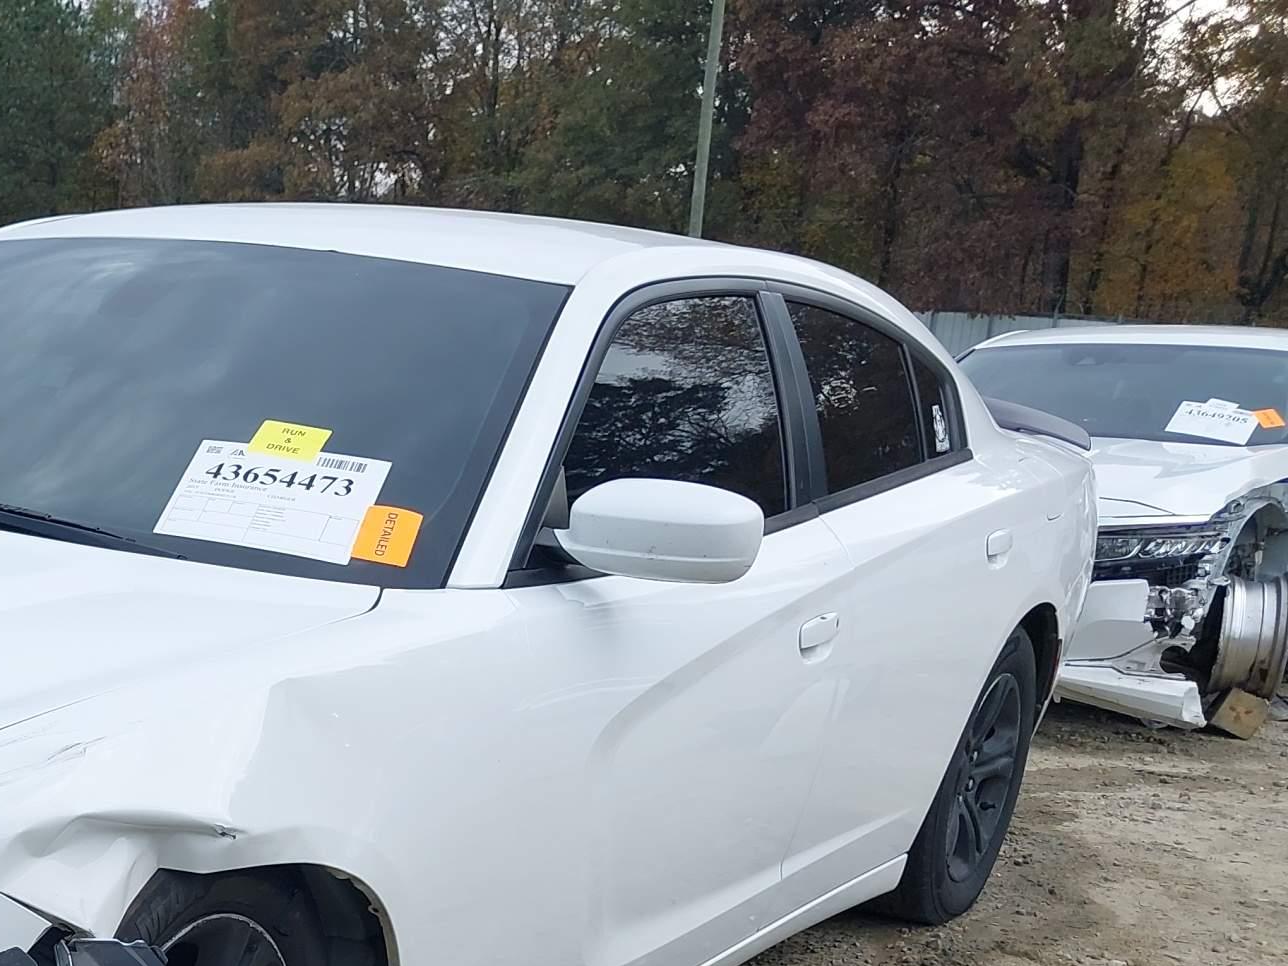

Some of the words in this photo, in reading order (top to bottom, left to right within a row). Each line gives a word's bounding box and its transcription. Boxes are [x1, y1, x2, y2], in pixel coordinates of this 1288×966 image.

[281, 427, 307, 437] RUN
[265, 442, 301, 455] DRIVE
[204, 462, 355, 497] 43654473
[374, 512, 399, 557] DETAILED
